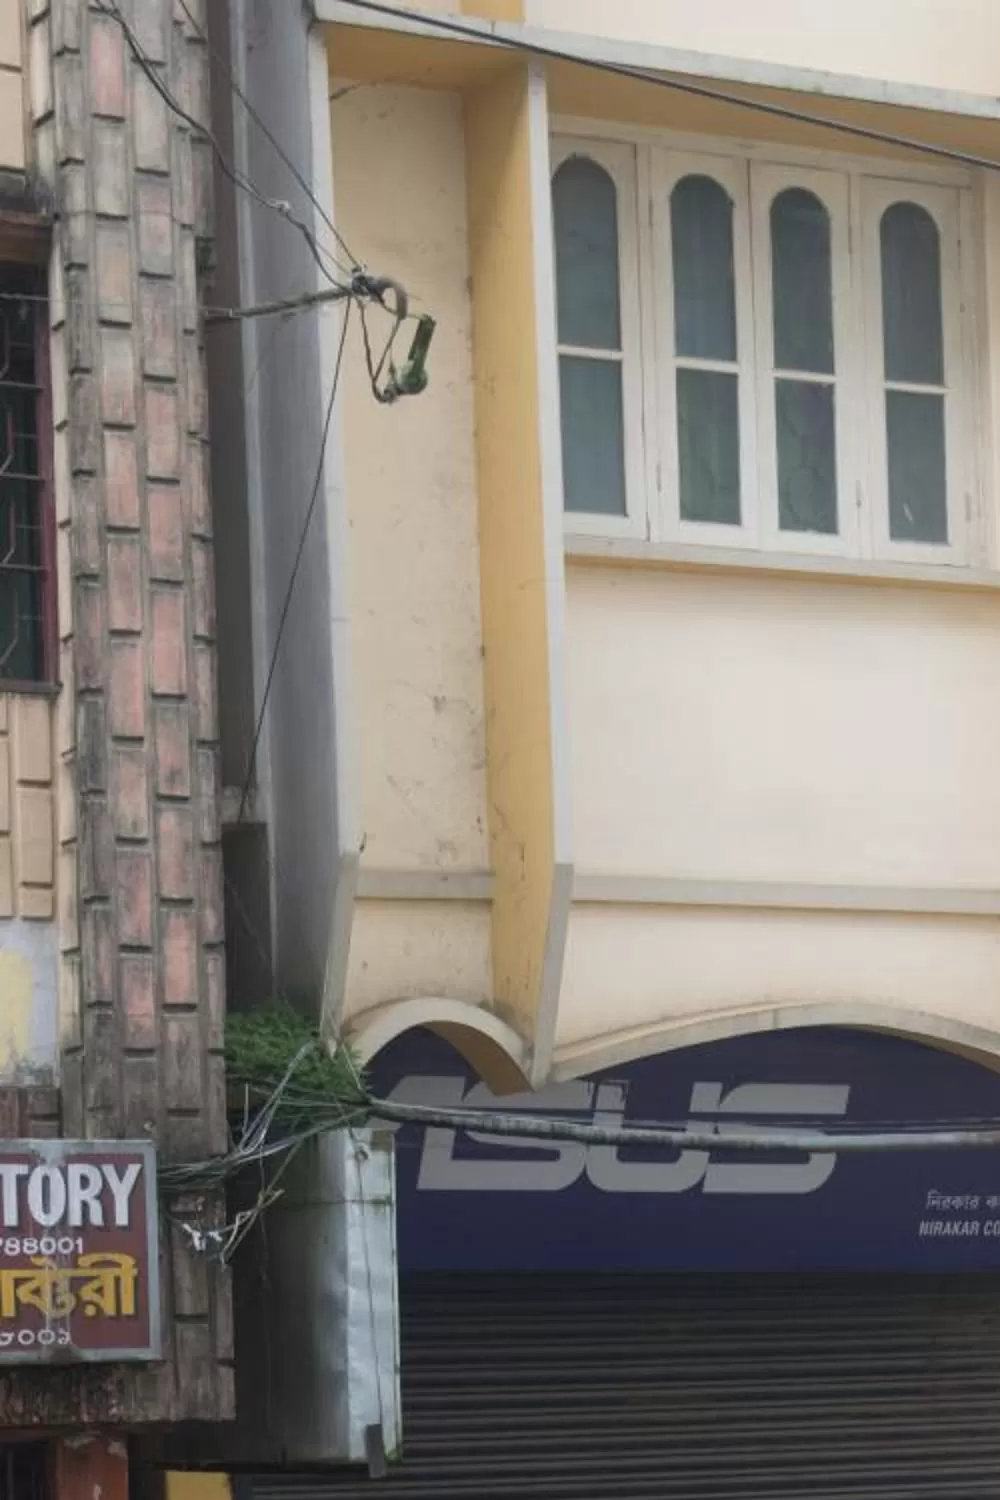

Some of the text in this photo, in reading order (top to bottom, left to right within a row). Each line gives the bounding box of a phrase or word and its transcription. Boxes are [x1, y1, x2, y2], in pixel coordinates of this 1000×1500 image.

[0, 1163, 142, 1228] TORY
[918, 1219, 980, 1238] NIRAKAR
[0, 1236, 84, 1255] 88001
